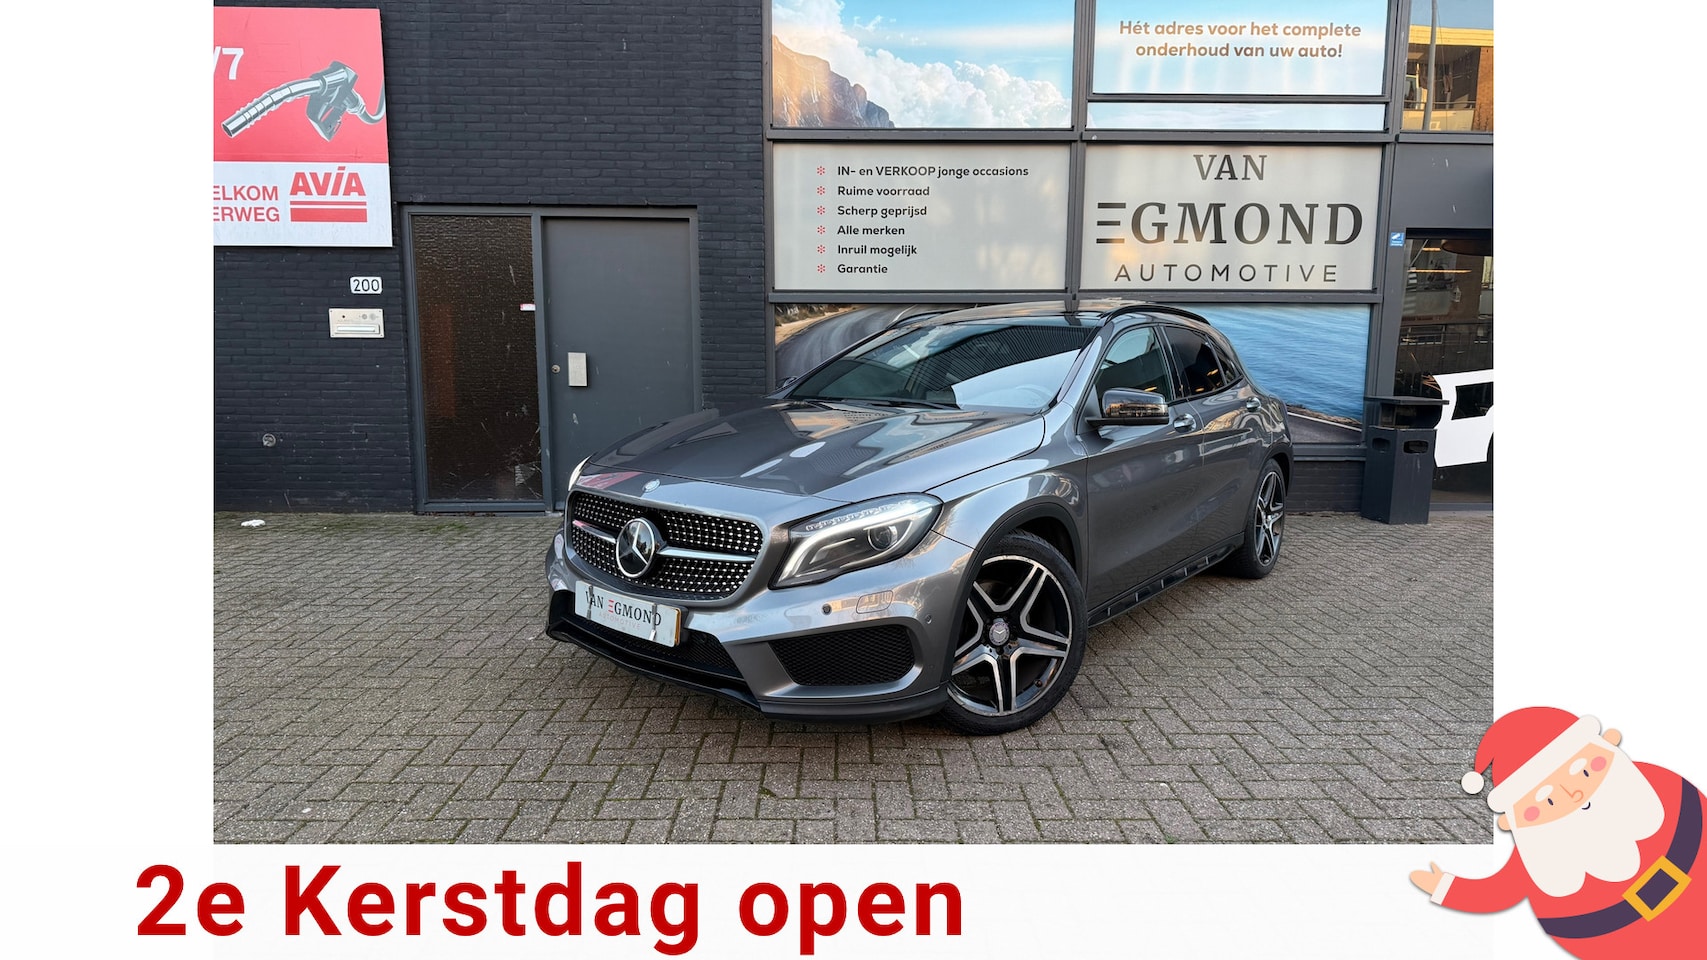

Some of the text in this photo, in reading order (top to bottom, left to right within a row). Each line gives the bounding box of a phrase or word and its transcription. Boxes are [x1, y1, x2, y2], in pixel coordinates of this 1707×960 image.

[1119, 21, 1362, 40] Hét adres voor het complete
[1135, 42, 1343, 58] onderhoud van uw auto!
[837, 166, 1029, 179] IN- en VERKOOP jonge occasions
[1193, 154, 1267, 181] VAN
[837, 186, 930, 196] Ruime voorraad
[837, 205, 927, 218] Scherp geprijsd
[837, 225, 905, 235] Alle merken
[1095, 202, 1363, 245] EGMOND
[837, 244, 917, 257] Inruil mogelijk
[837, 263, 888, 274] Garantie
[1114, 264, 1337, 283] AUTOMOTIVE
[353, 278, 380, 292] 200
